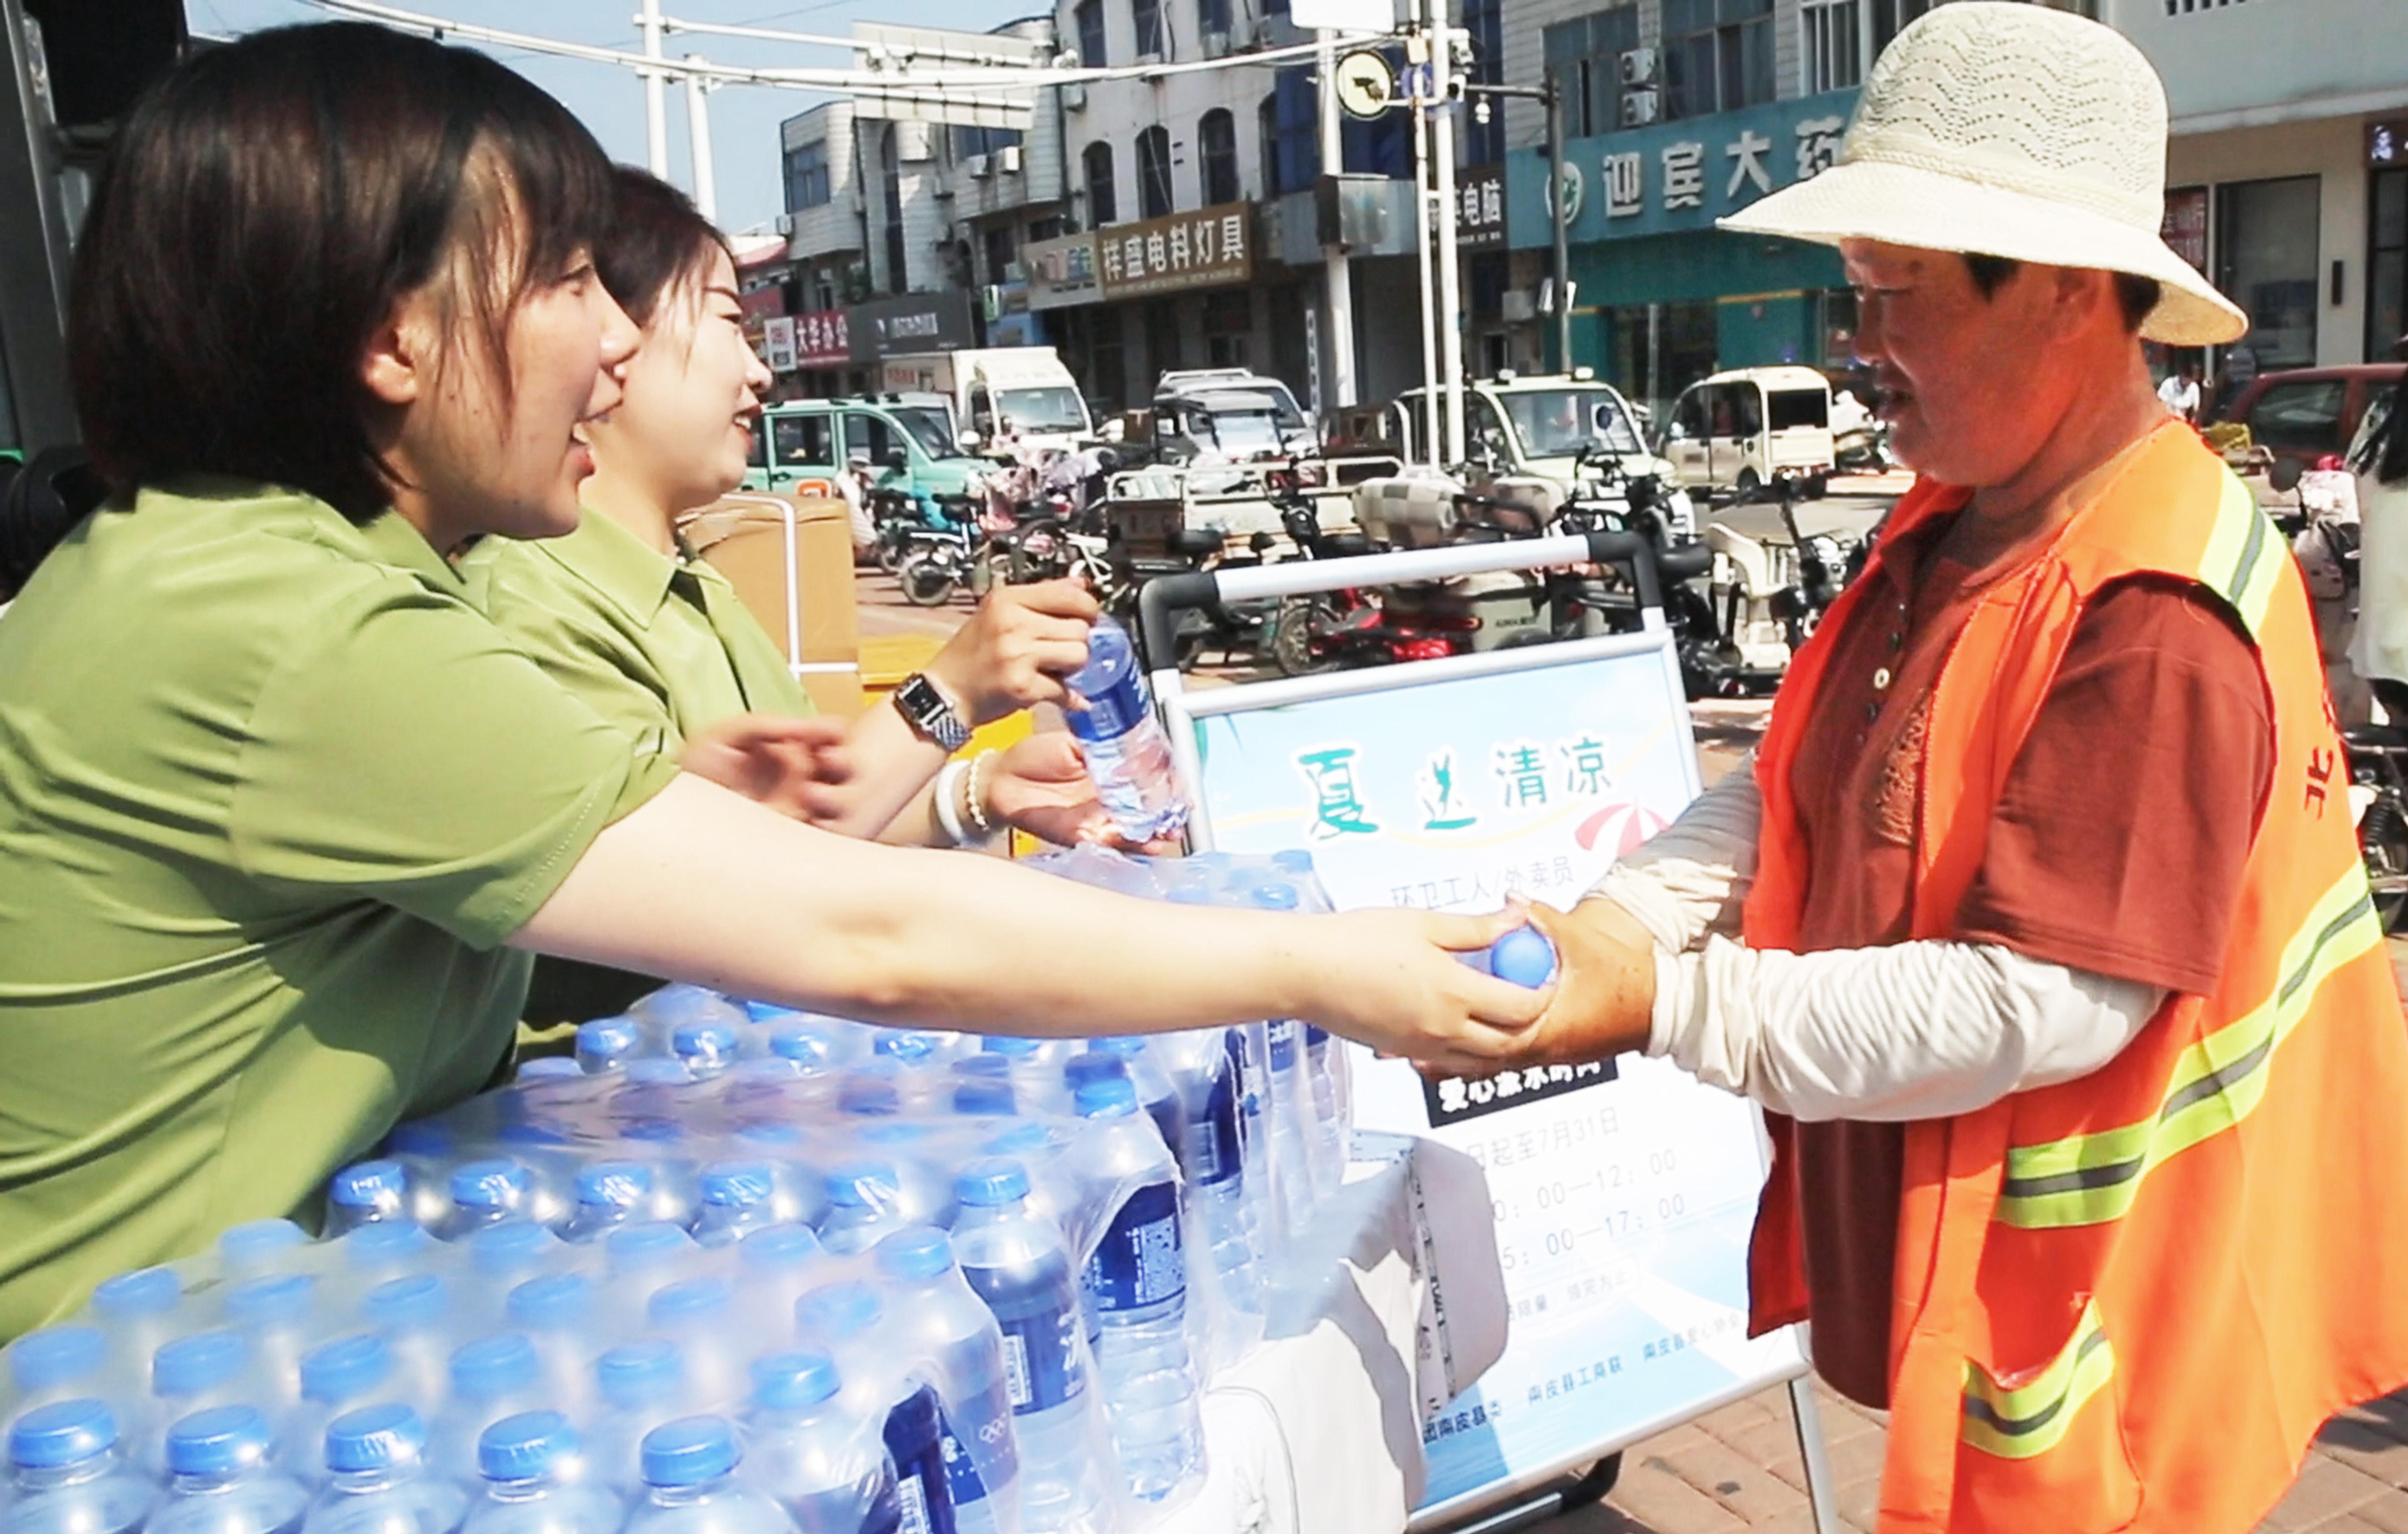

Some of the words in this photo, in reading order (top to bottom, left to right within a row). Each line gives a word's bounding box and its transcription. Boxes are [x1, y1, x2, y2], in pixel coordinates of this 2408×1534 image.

[1603, 114, 1844, 219] 迎宾大药
[1102, 214, 1243, 281] 祥盛电料灯具
[1299, 736, 1611, 840] 夏送清凉
